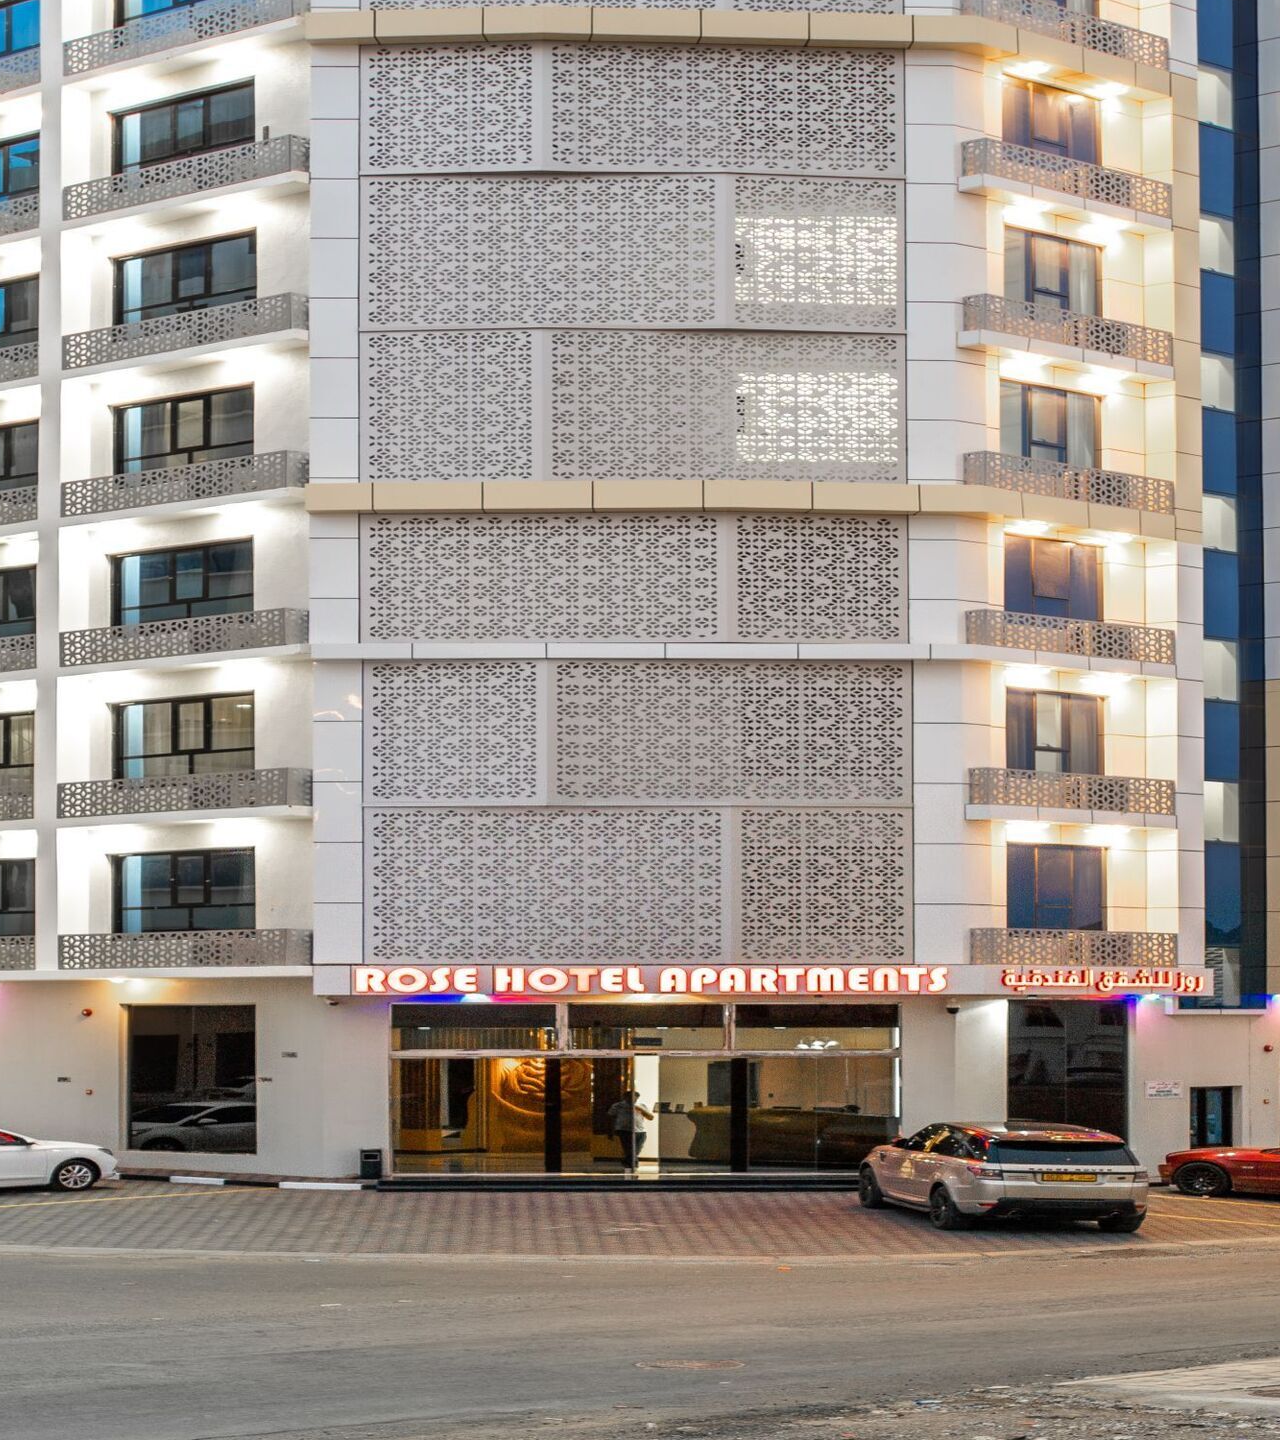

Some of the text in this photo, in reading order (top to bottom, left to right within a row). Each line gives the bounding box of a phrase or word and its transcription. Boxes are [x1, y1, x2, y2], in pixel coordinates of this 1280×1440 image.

[354, 966, 948, 993] ROSE HOTEL APARTMENTS
[1001, 966, 1205, 993] روز للشقق الفندقية
